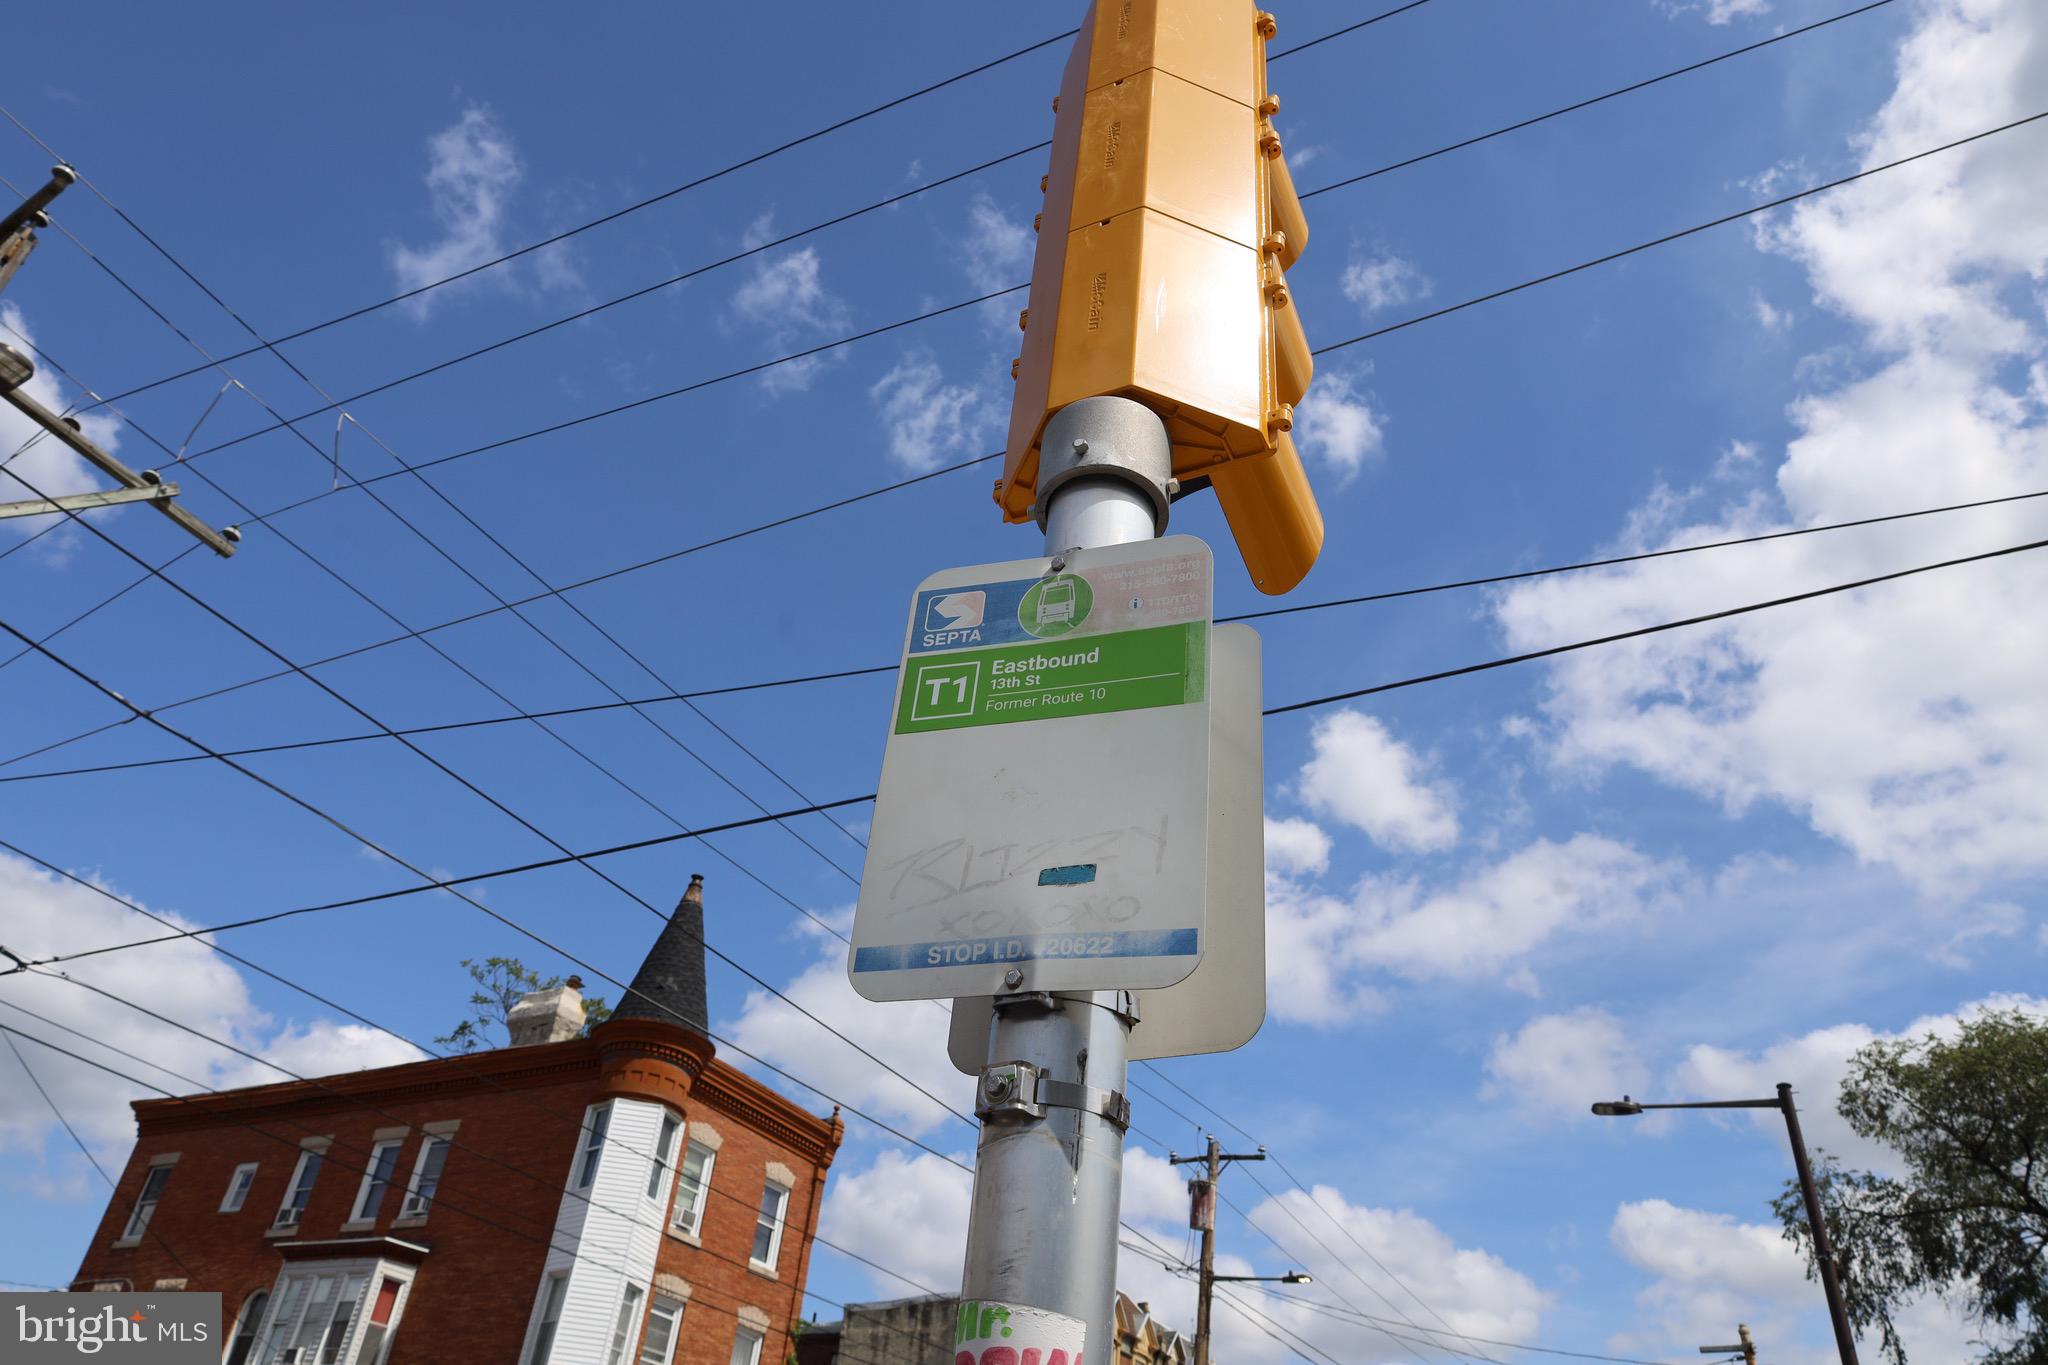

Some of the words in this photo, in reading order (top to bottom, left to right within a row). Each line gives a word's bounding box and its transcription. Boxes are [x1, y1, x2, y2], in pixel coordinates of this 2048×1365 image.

[923, 629, 982, 647] SEPTA
[991, 647, 1100, 675] Eastbound
[925, 675, 968, 706] T1
[990, 676, 1021, 690] 13th
[1024, 675, 1041, 687] St
[985, 698, 1036, 712] Former
[1041, 690, 1084, 706] Route
[1089, 687, 1106, 700] 10
[927, 942, 987, 965] STOP
[993, 940, 1026, 960] I.D.
